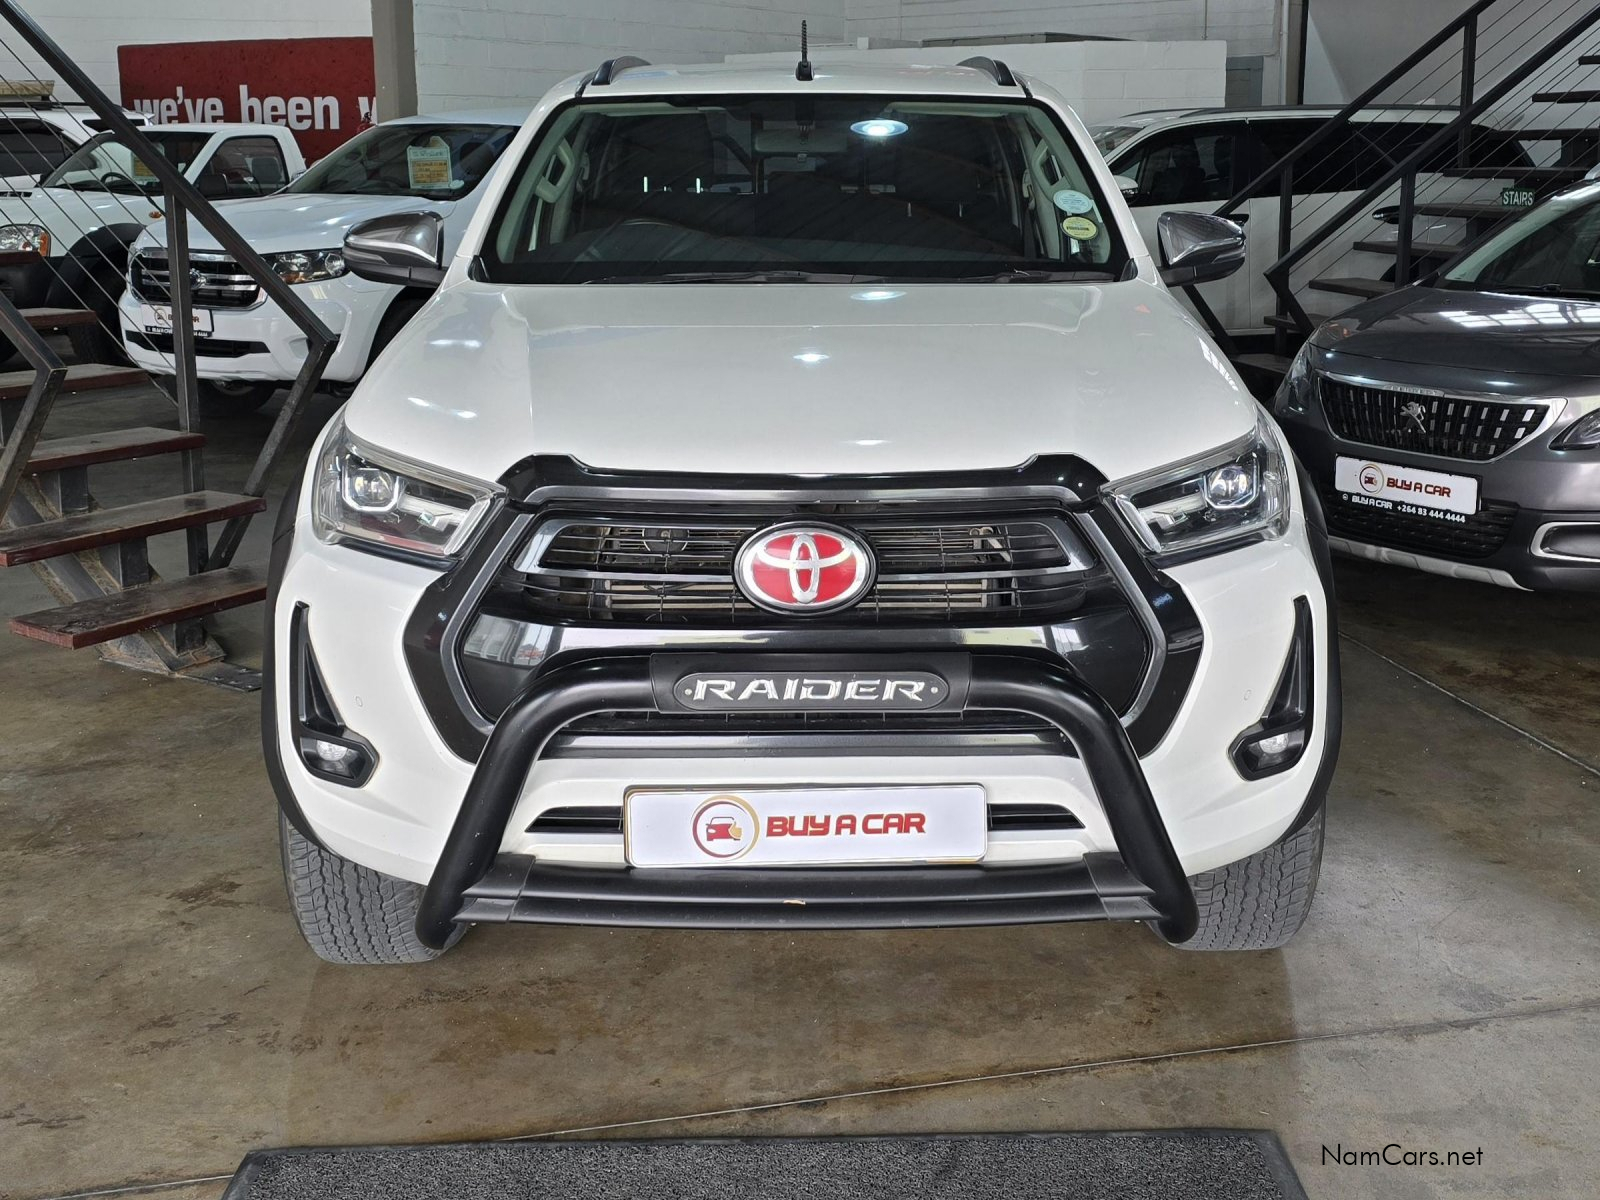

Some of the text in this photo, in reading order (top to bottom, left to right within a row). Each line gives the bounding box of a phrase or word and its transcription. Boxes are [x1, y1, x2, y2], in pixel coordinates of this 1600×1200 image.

[134, 85, 224, 124] we've
[239, 84, 340, 130] been
[1502, 191, 1534, 206] STAIRS
[1386, 477, 1452, 498] BUY A CAR
[1351, 495, 1466, 523] BUY A CAR +264 83 444 4444
[693, 678, 926, 702] RAIDER
[766, 812, 926, 837] BUY A CAR
